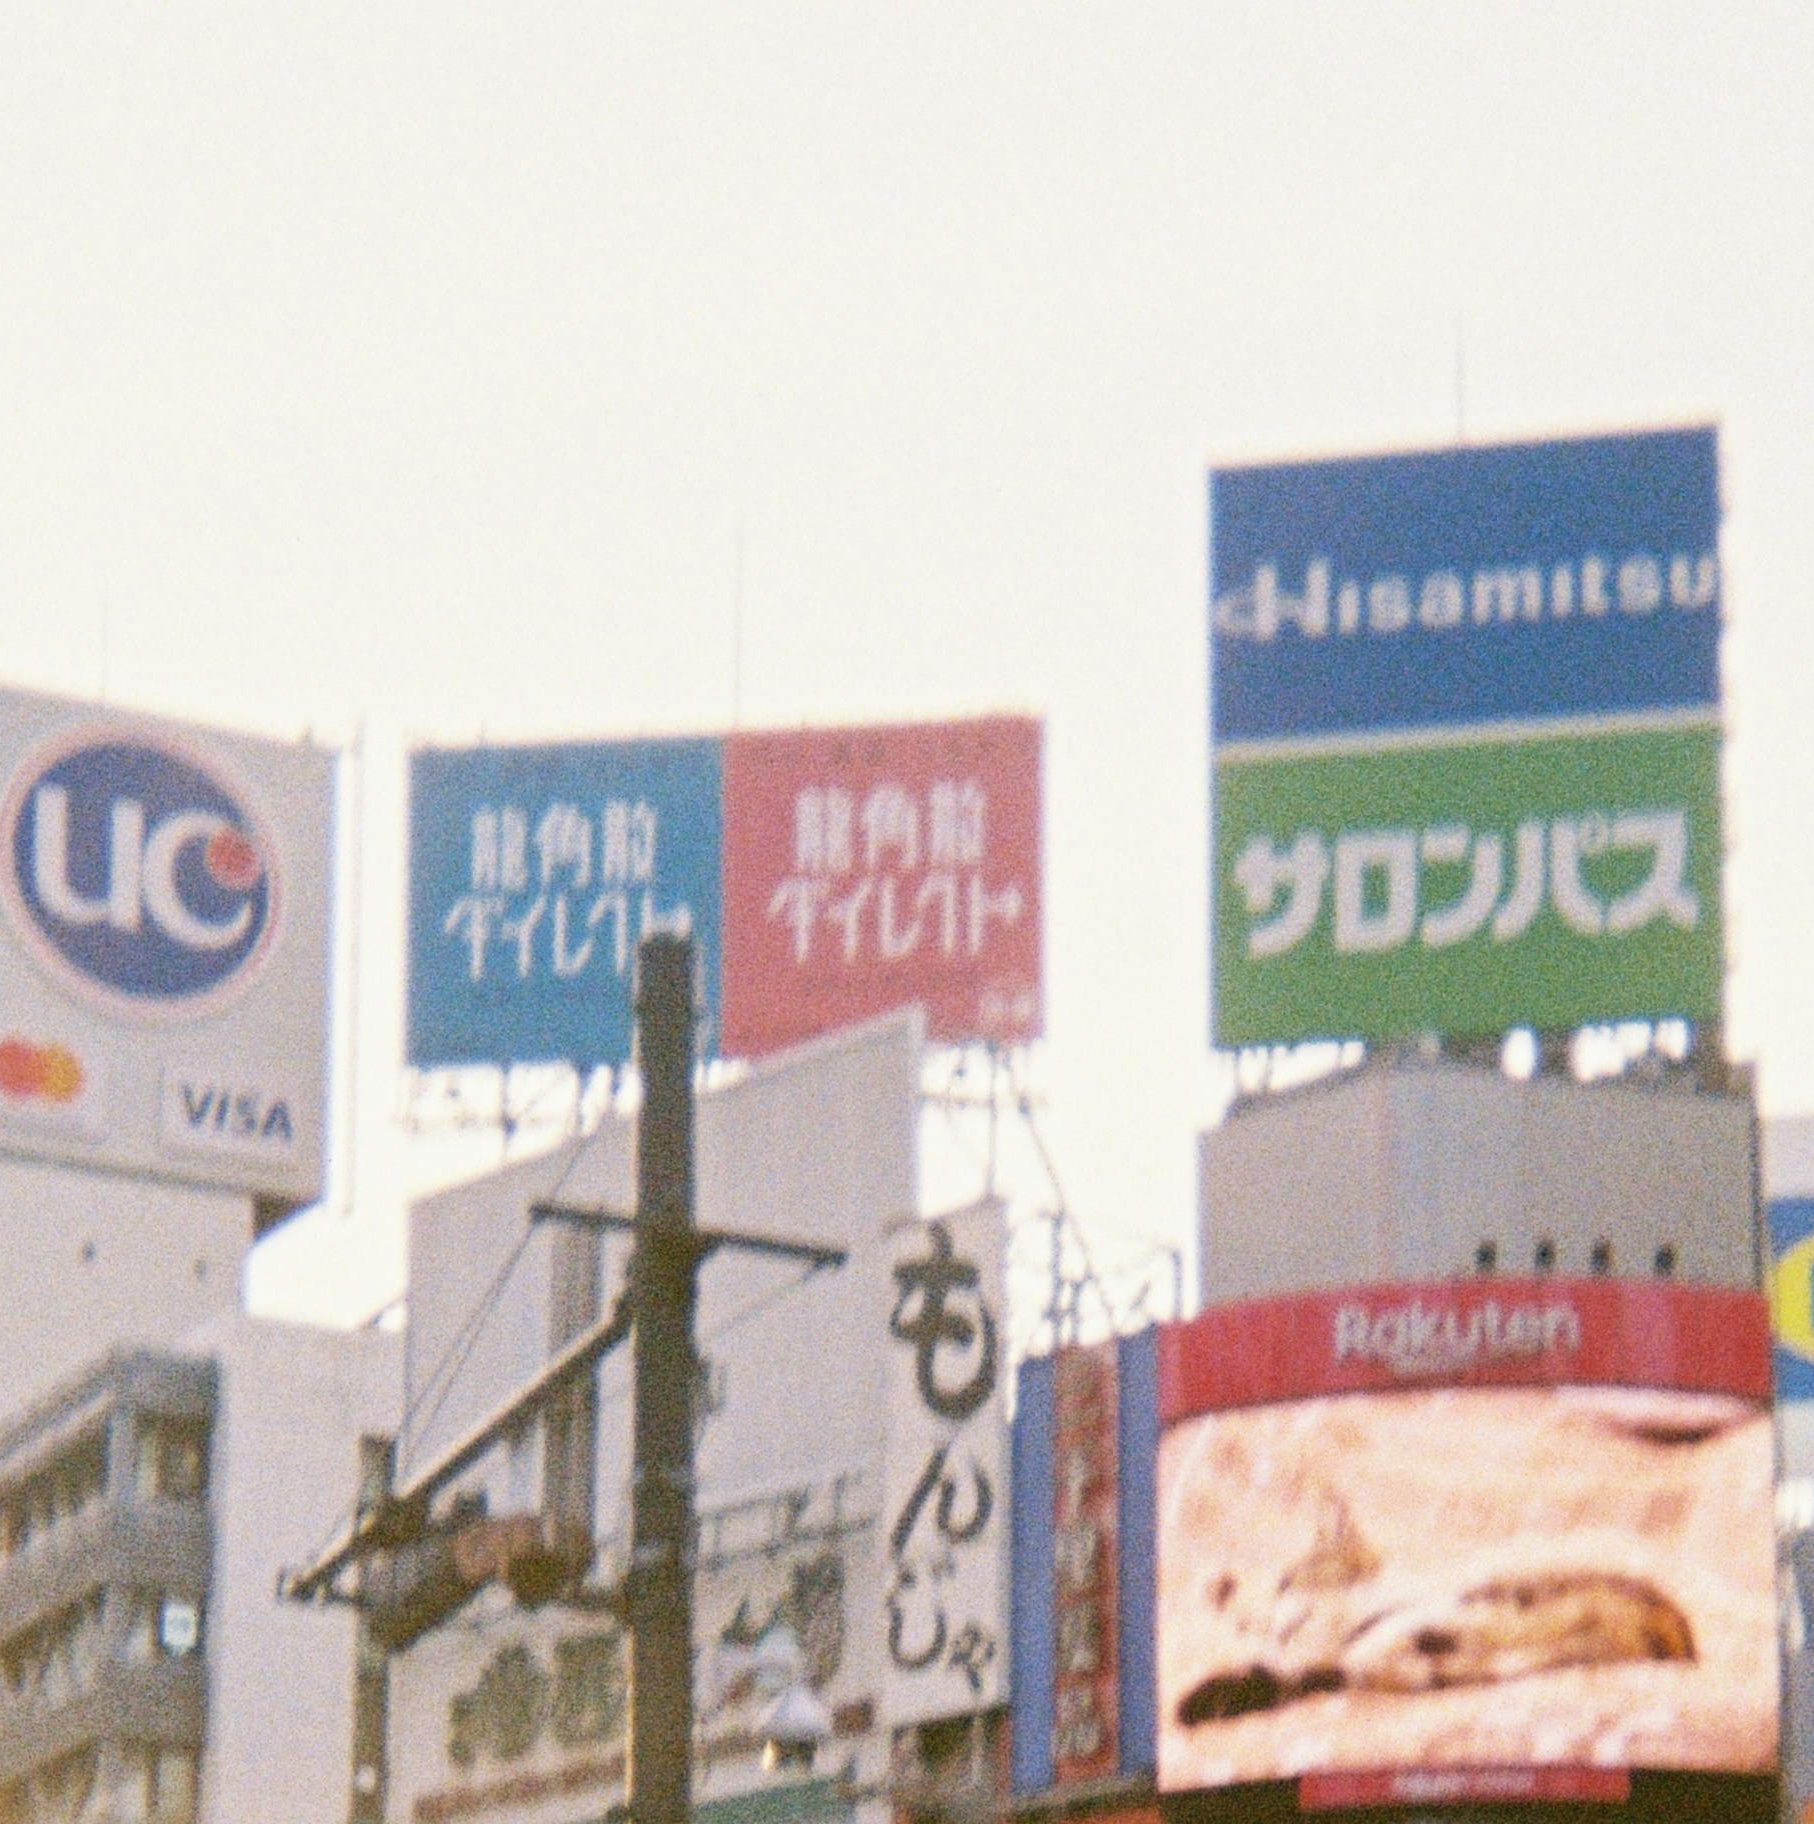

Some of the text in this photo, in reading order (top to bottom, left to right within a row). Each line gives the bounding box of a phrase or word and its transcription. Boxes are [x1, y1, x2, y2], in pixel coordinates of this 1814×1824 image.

[1253, 548, 1718, 643] Hisamitsu
[1233, 810, 1700, 960] サロンパス
[181, 1080, 295, 1143] VISA
[1333, 1299, 1581, 1364] Rakuten
[889, 1220, 999, 1692] もんじゃ
